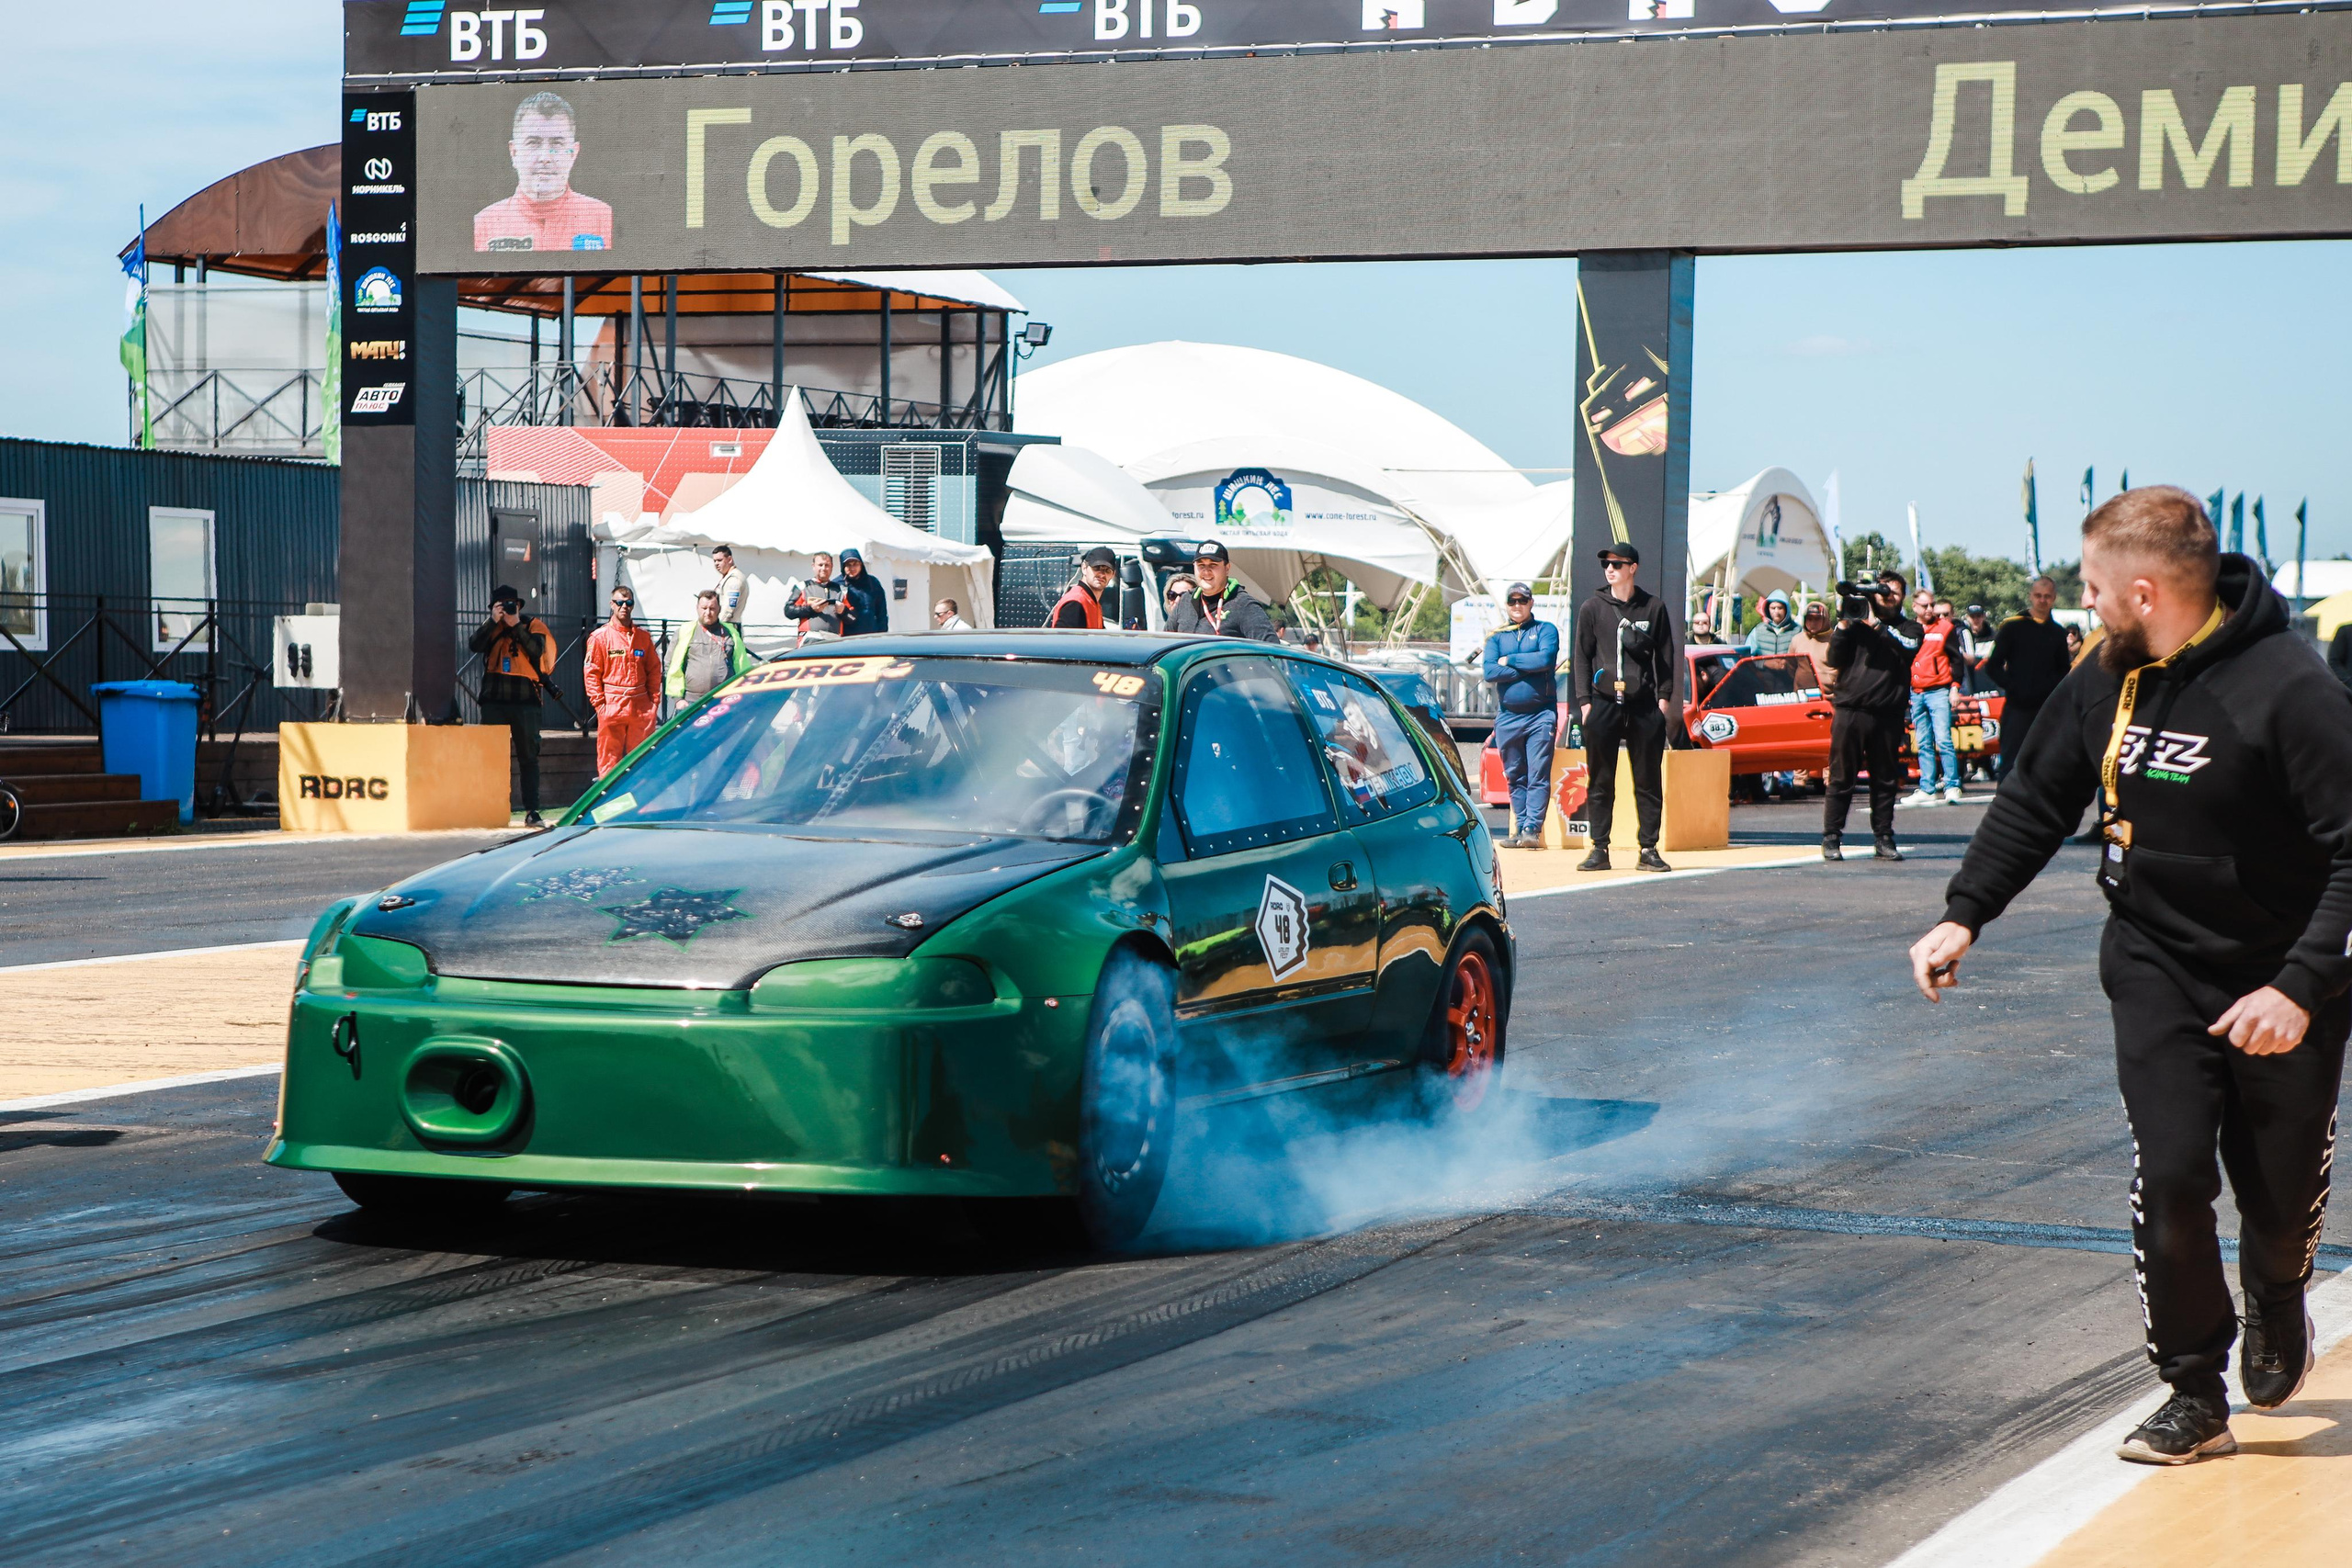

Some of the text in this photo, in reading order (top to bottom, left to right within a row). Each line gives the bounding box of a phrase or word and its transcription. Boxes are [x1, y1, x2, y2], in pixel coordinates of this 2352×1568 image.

[449, 8, 548, 62] ВТБ
[761, 0, 865, 51] ВТБ
[367, 111, 402, 131] ВТБ
[1901, 61, 2352, 219] Деми
[686, 107, 1233, 245] Горелов
[352, 185, 405, 195] НОРНИКЕЛЬ
[350, 340, 406, 360] МАТЧ!
[359, 389, 399, 401] АВТО
[1222, 474, 1283, 501] ШИШКИН ЛЕС
[1305, 512, 1377, 522] www.cone-forest.ru
[1091, 671, 1146, 696] 48
[1311, 688, 1337, 711] ВТБ
[2144, 768, 2169, 781] ACING
[299, 774, 389, 801] RDRC
[1568, 823, 1589, 833] RD
[1274, 914, 1291, 944] 48
